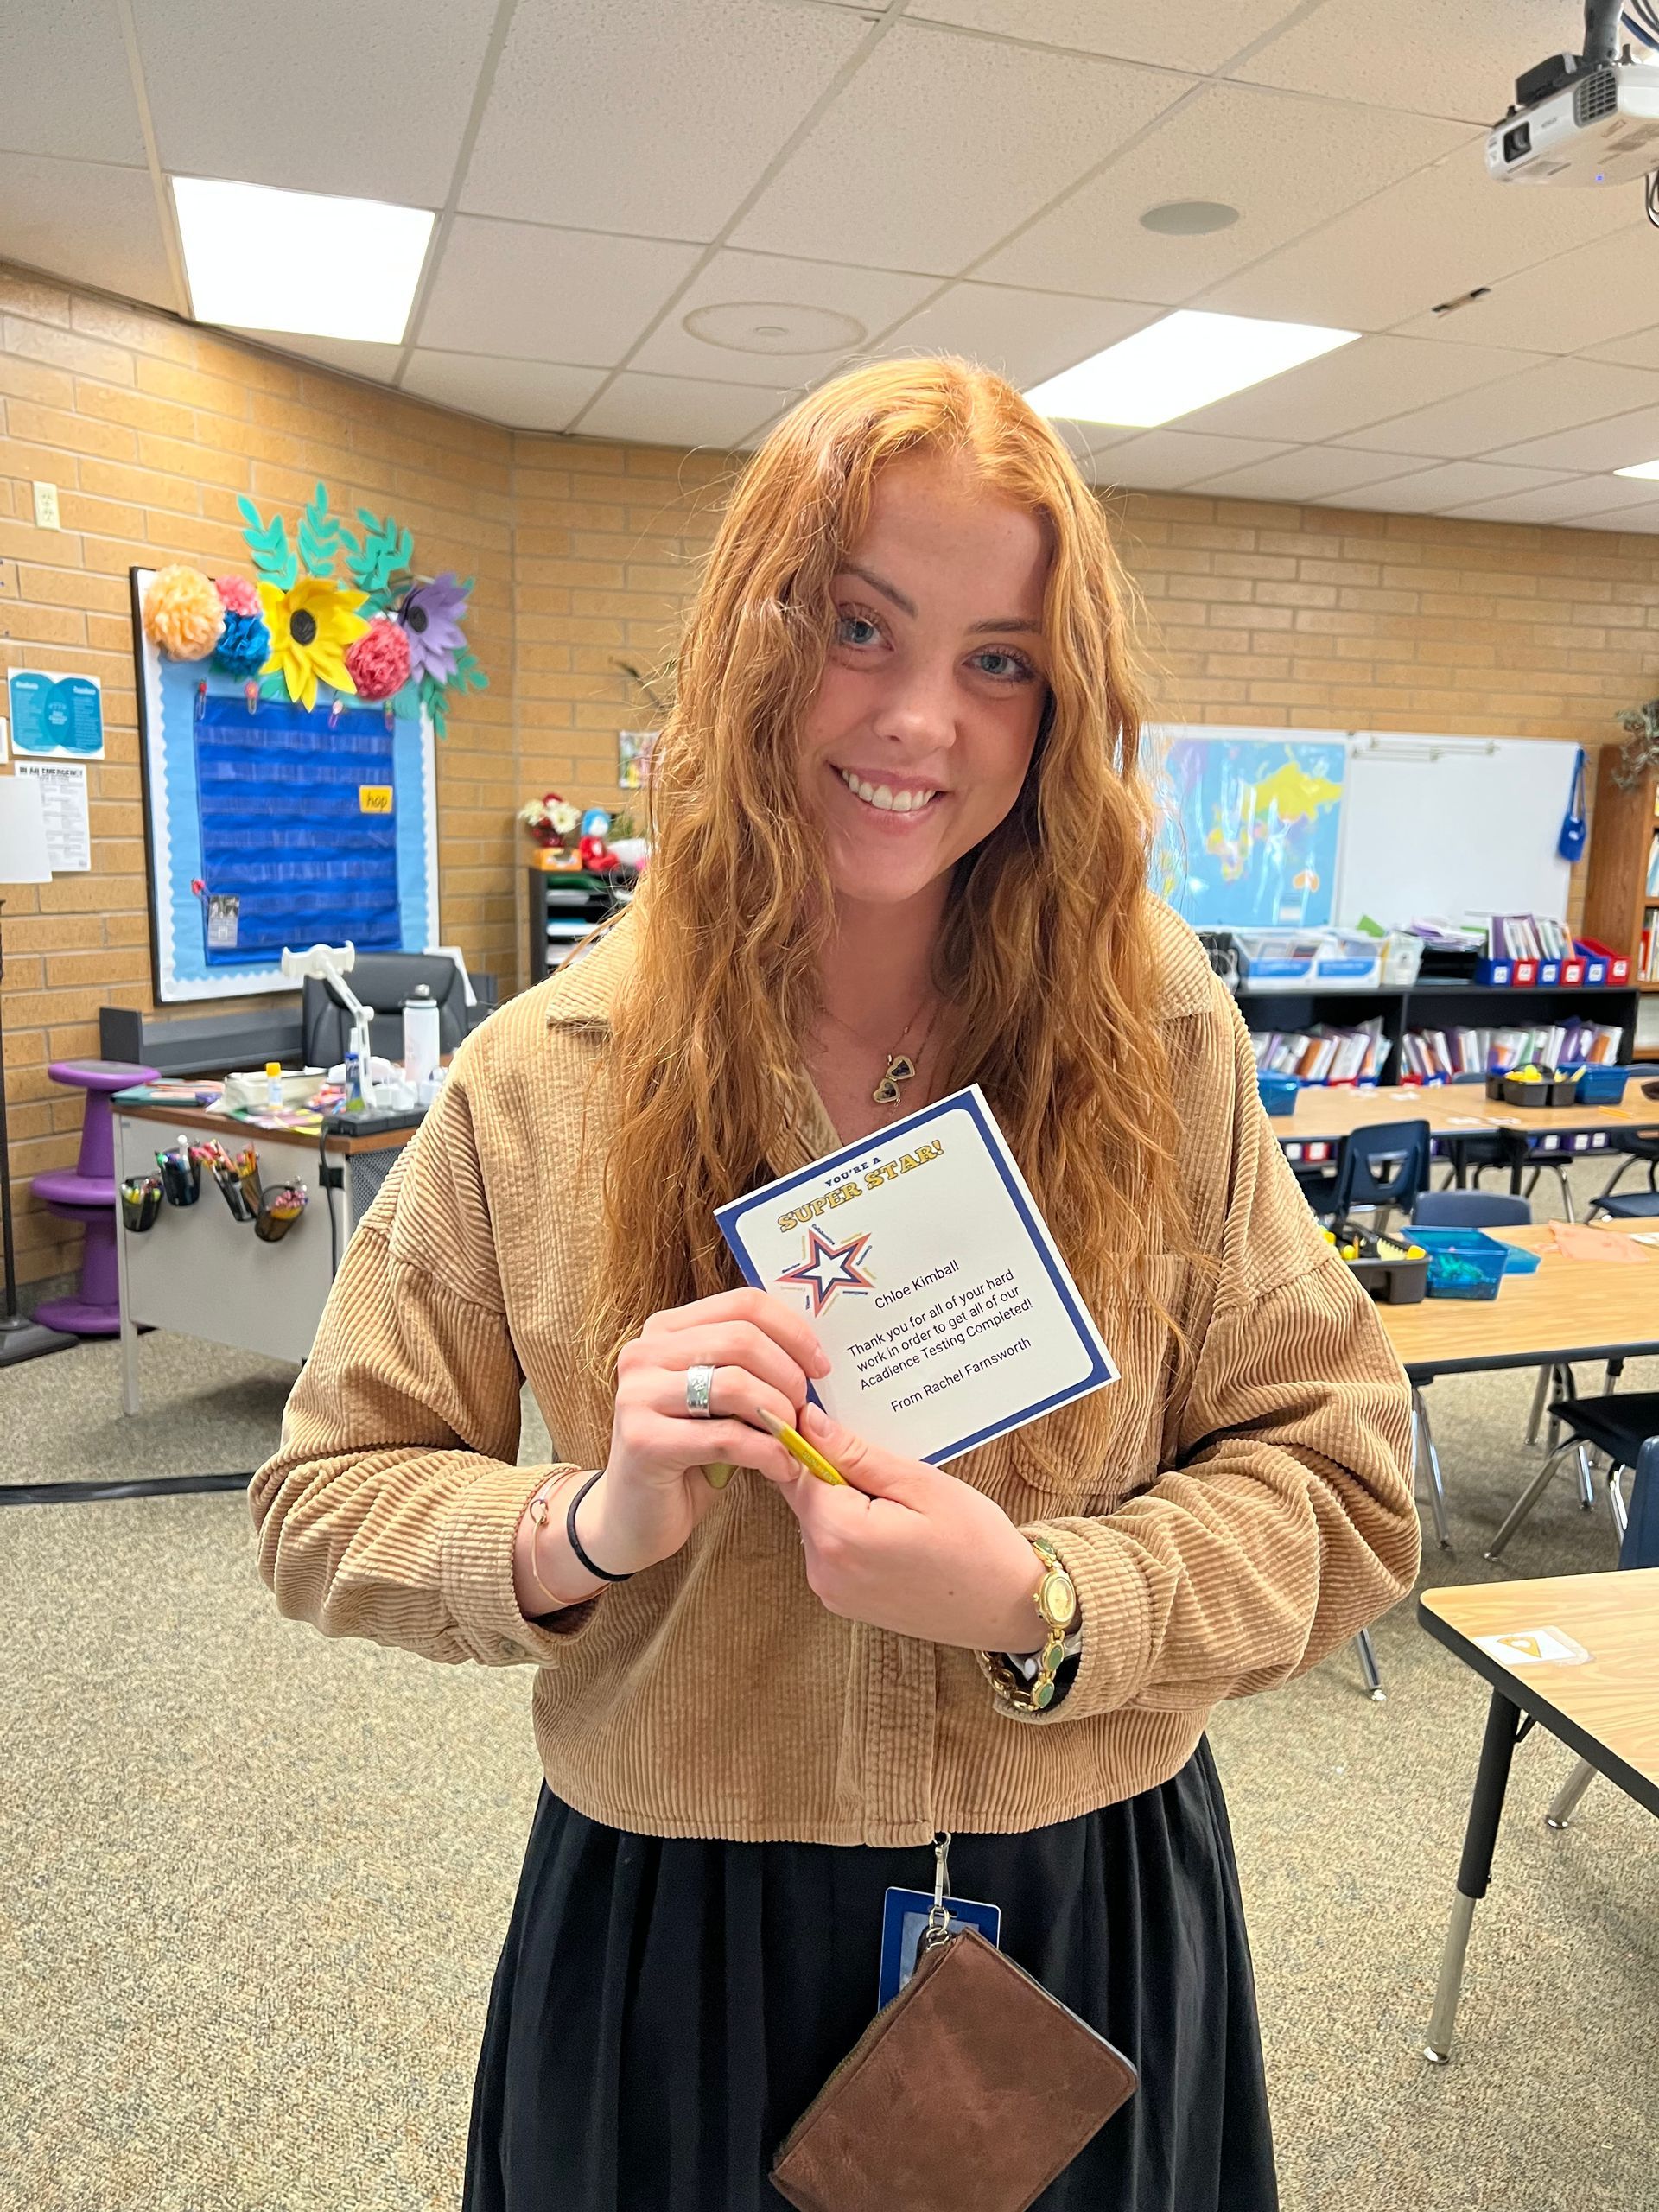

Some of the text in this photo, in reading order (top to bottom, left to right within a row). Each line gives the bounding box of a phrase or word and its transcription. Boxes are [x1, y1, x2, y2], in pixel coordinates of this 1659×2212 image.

[366, 791, 388, 812] hop
[777, 1139, 944, 1233] SUPER STAR!
[824, 1162, 869, 1187] YOU'RE
[847, 1268, 1014, 1357] Thank you for all of your hard
[874, 1259, 959, 1308] Chloe Kimball
[856, 1287, 1019, 1372] work in order to get all of our
[861, 1298, 1033, 1391] Acadience Testing Completed!
[891, 1338, 1031, 1412] From Rachel Farnsworth
